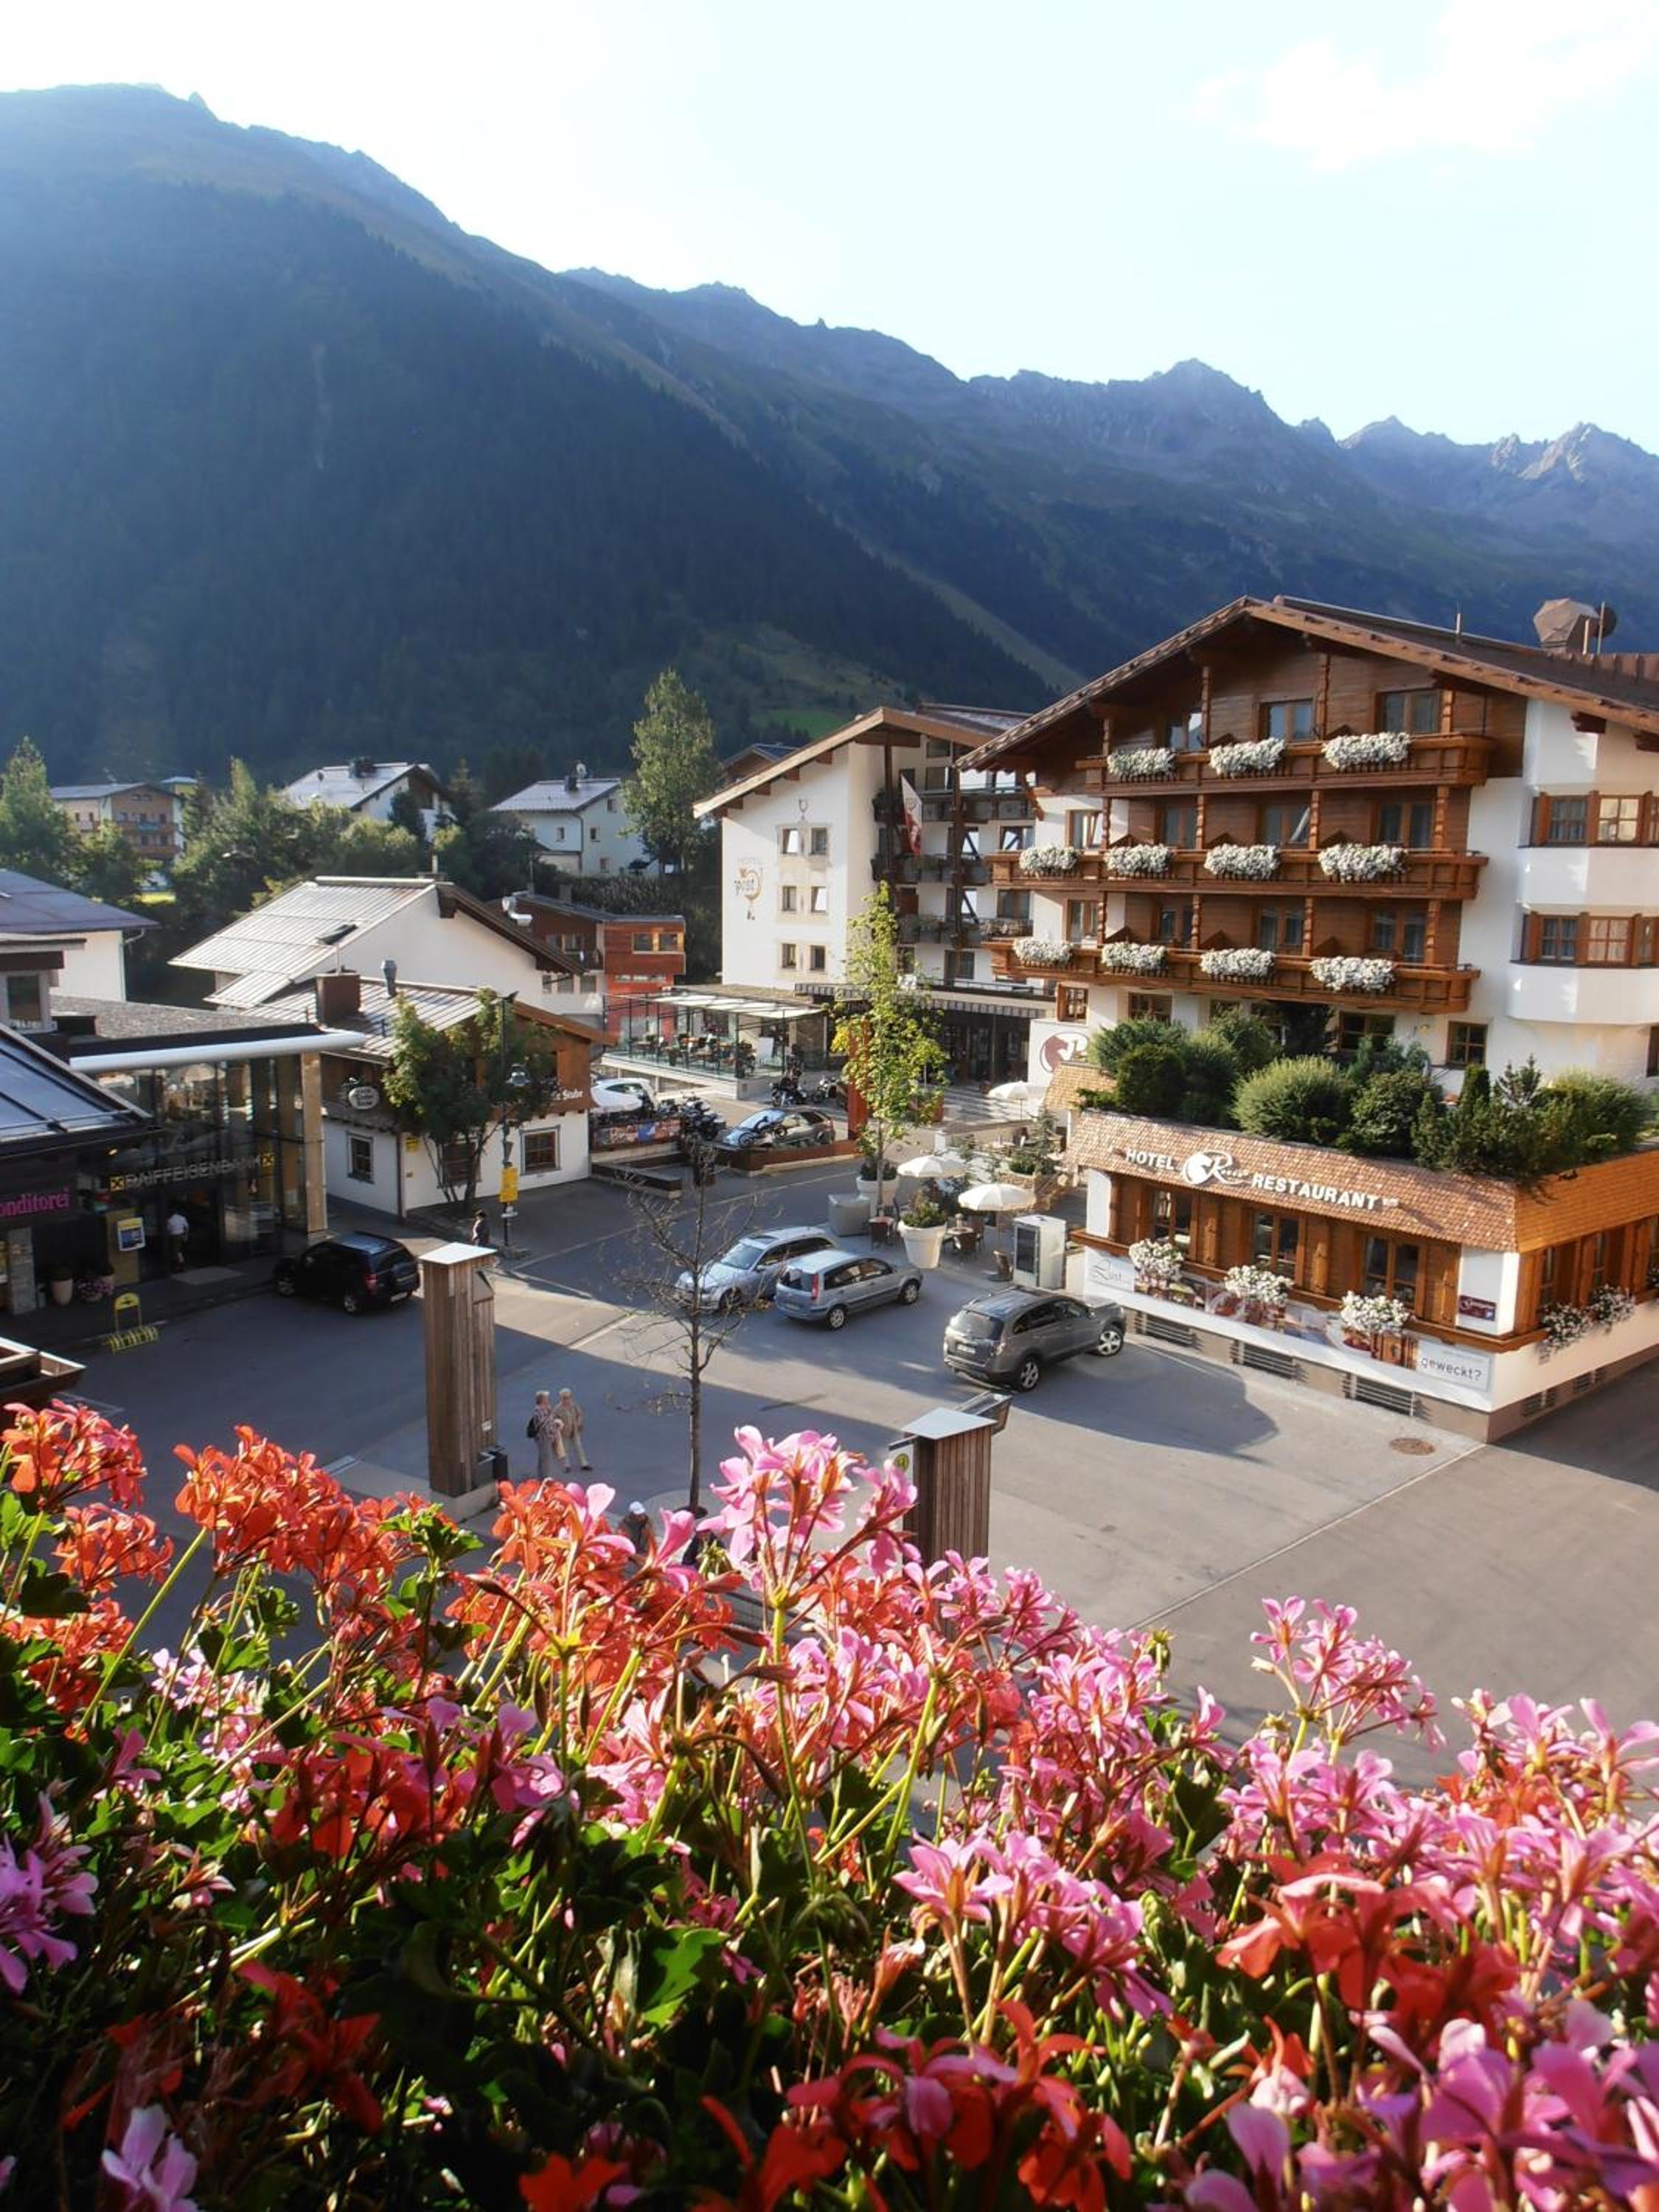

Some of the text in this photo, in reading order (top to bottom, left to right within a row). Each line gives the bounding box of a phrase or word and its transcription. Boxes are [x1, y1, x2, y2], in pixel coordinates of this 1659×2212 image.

[125, 1153, 260, 1189] RAIFFEISENBANK
[1126, 1148, 1175, 1170] HOTEL
[1251, 1172, 1380, 1210] RESTAURANT
[1421, 1357, 1482, 1381] geweckt?
